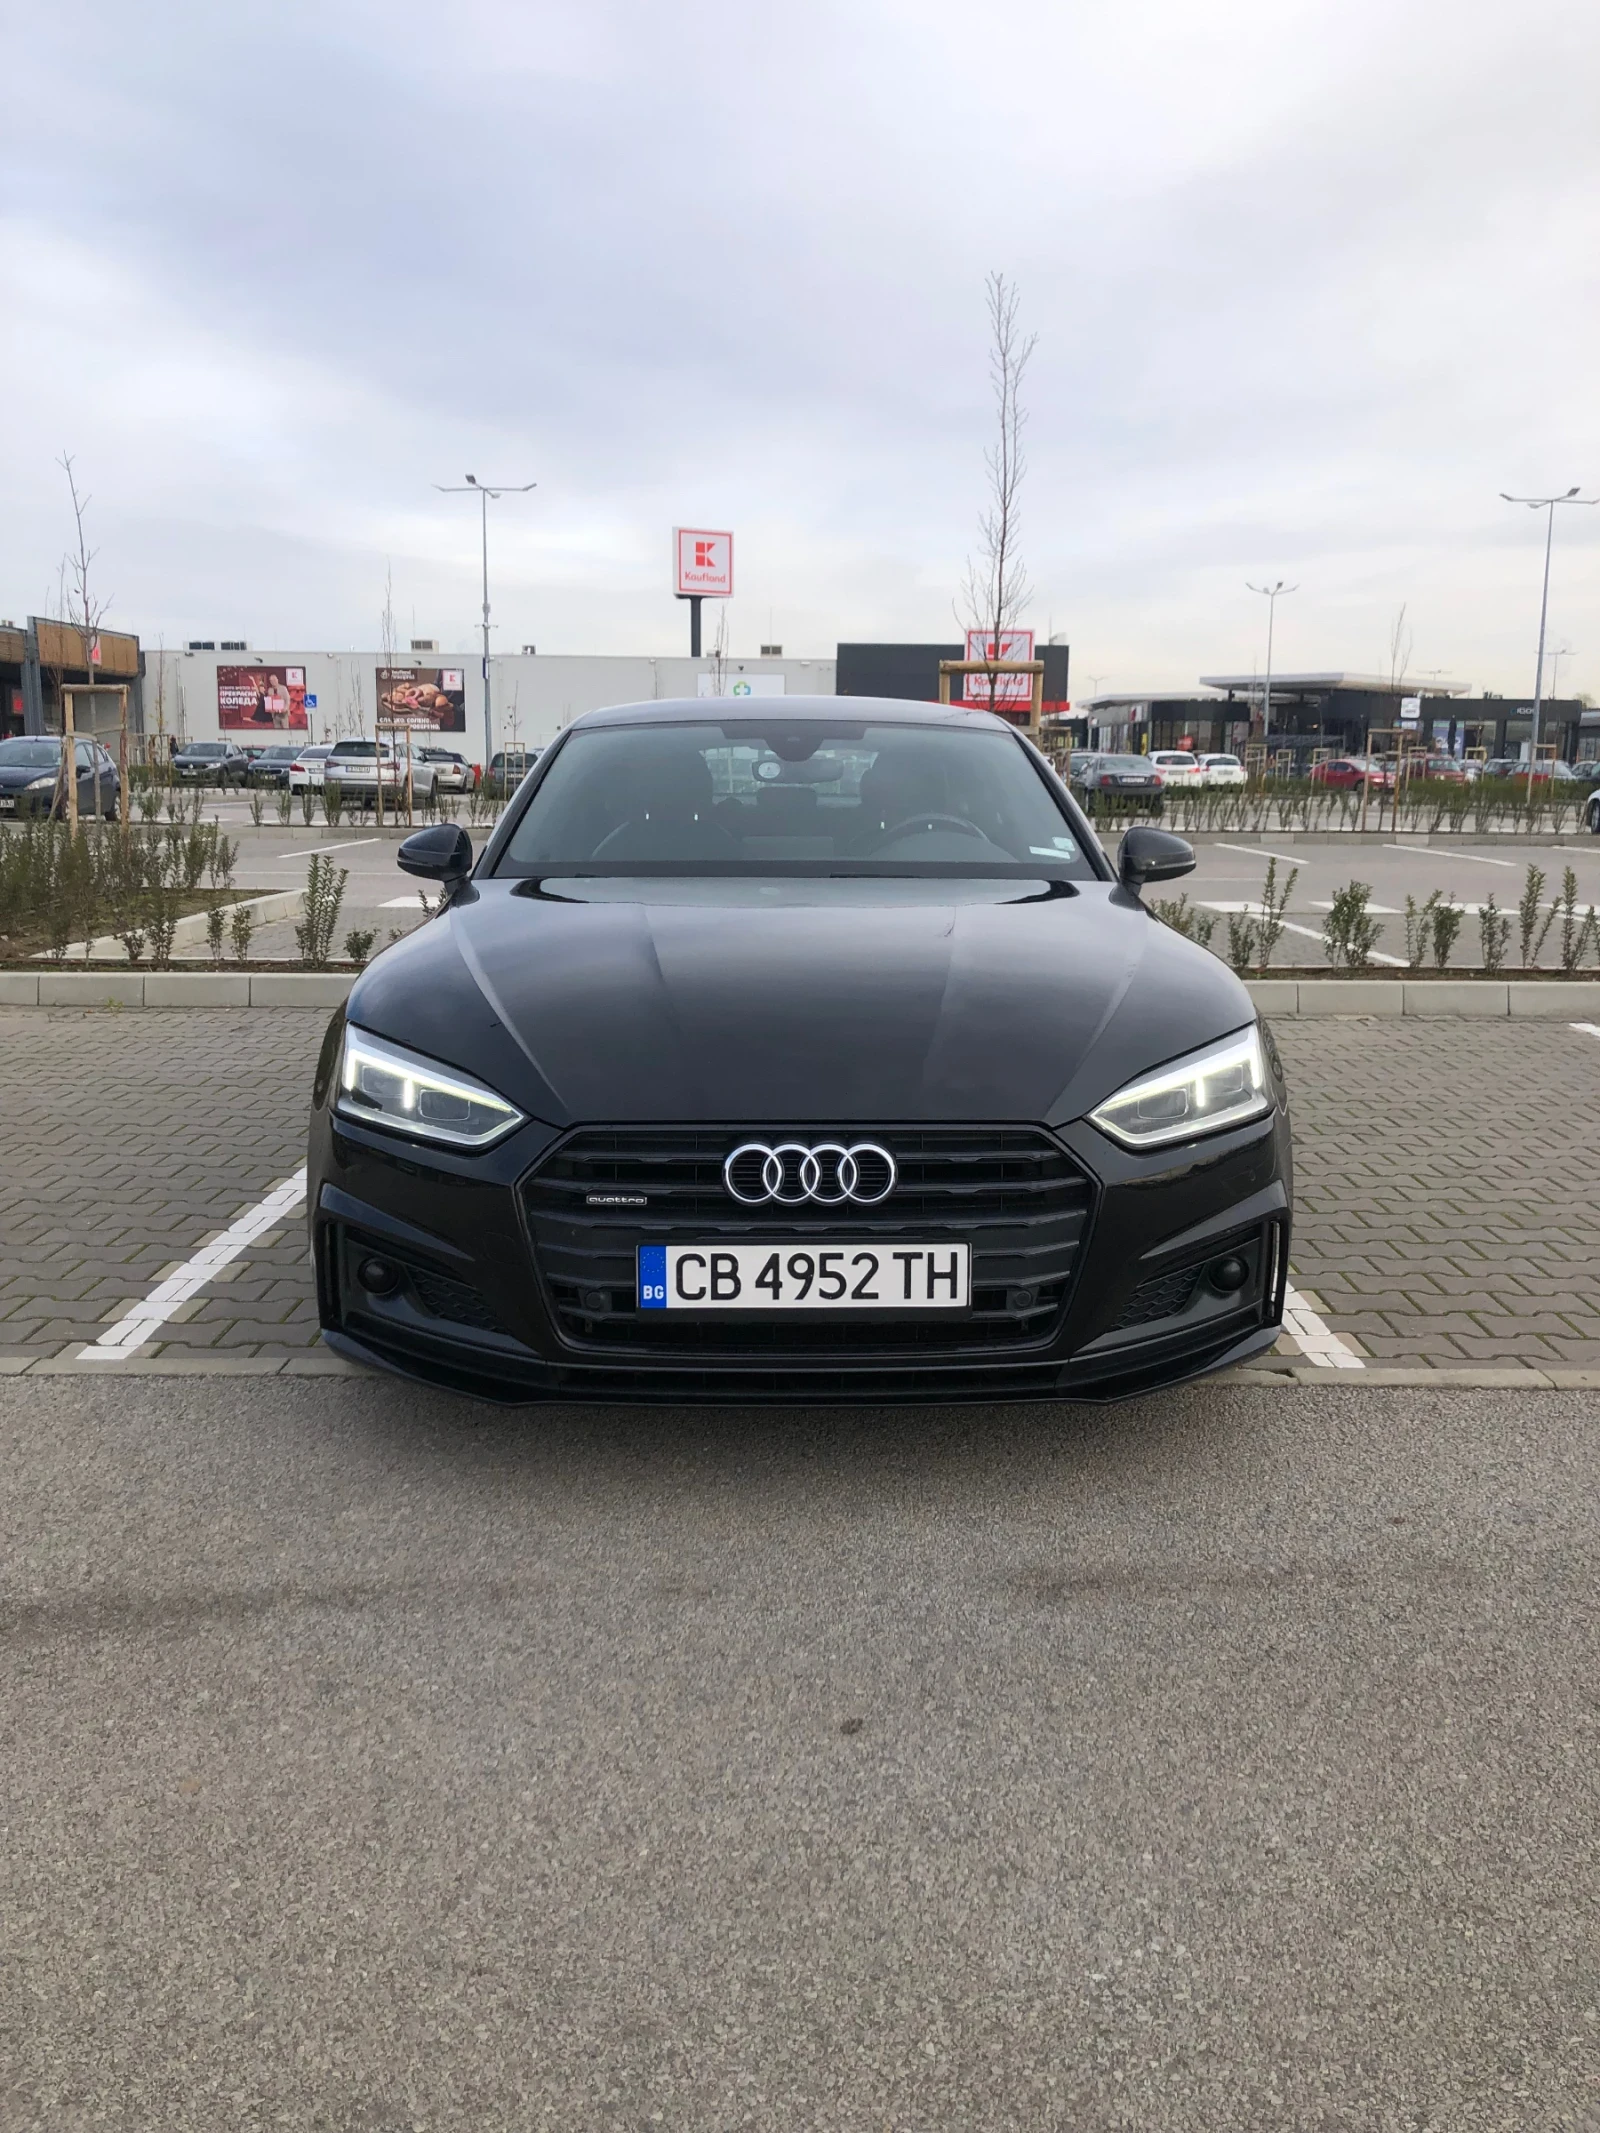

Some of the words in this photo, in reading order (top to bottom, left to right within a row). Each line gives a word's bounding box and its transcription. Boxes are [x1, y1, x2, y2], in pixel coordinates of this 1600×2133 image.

[684, 571, 726, 583] Kaufland
[220, 697, 258, 706] КОЛЕДА
[675, 1252, 742, 1301] CB
[754, 1251, 880, 1301] 4952
[892, 1251, 958, 1300] TH
[643, 1285, 665, 1300] BG
